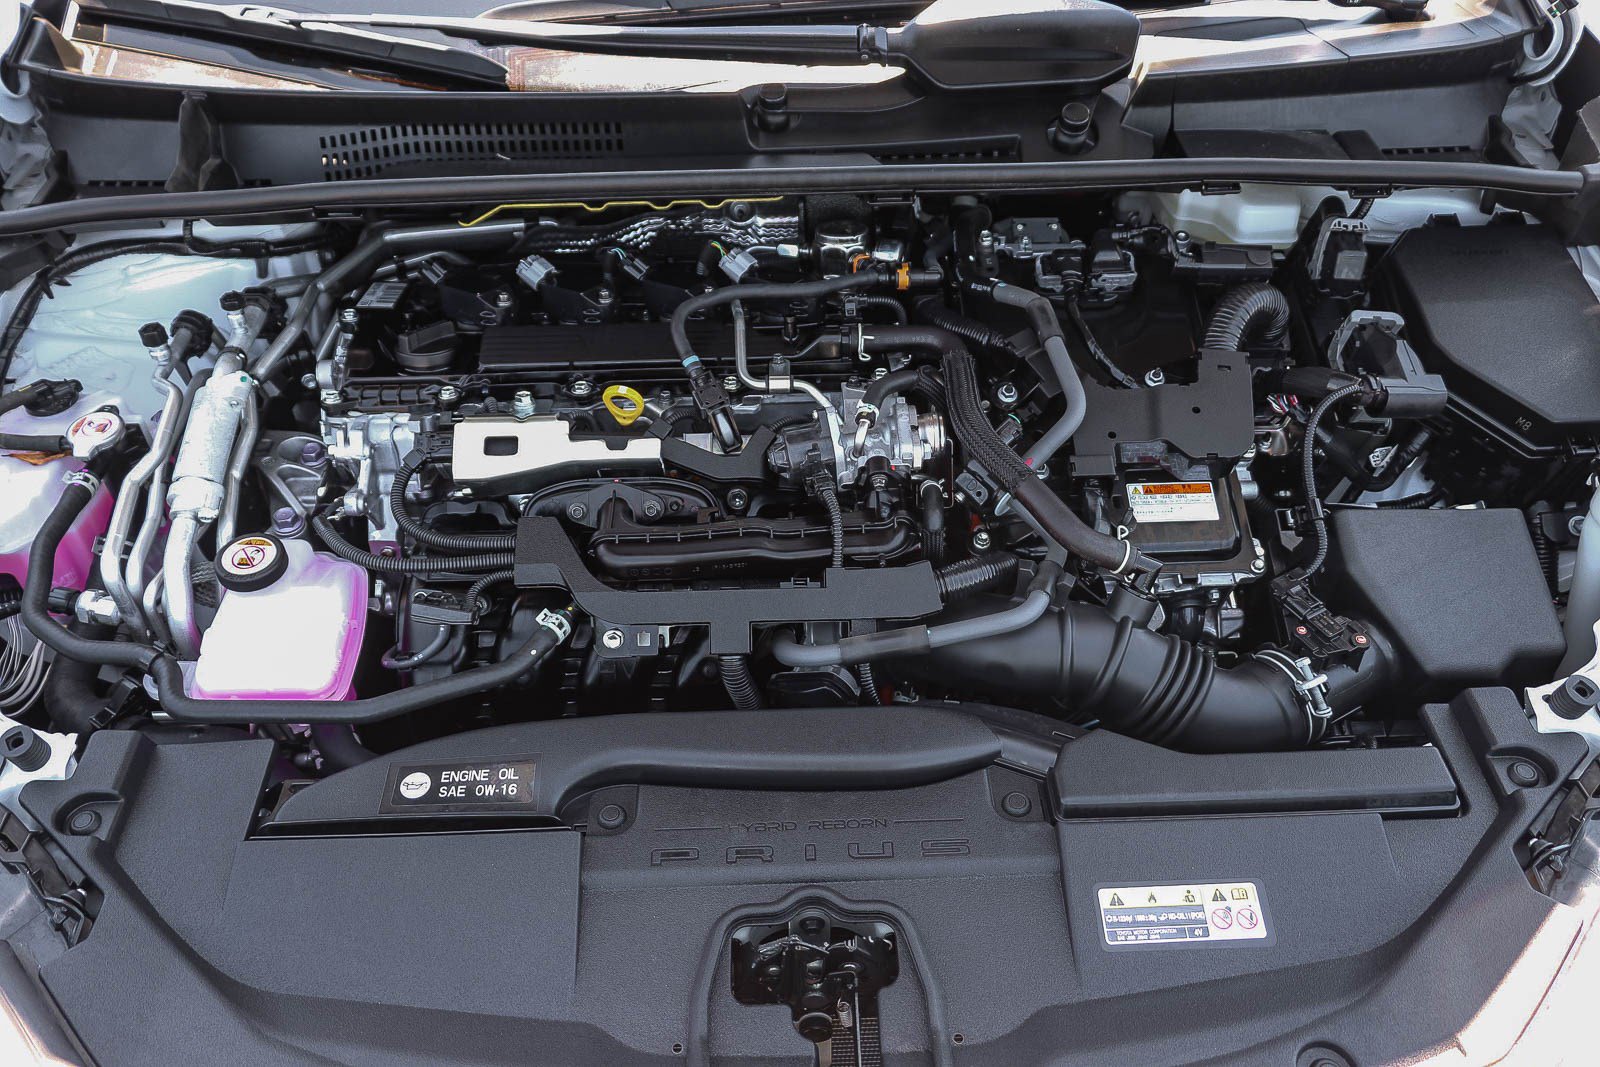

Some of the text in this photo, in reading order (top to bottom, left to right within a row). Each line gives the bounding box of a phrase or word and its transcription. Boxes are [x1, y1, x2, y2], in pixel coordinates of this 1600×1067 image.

[1515, 416, 1532, 431] M8
[441, 768, 519, 782] ENGINE OIL
[438, 783, 518, 797] SAE 0W-16
[726, 818, 888, 833] HYBRID REBORN
[650, 838, 971, 867] PRIUS
